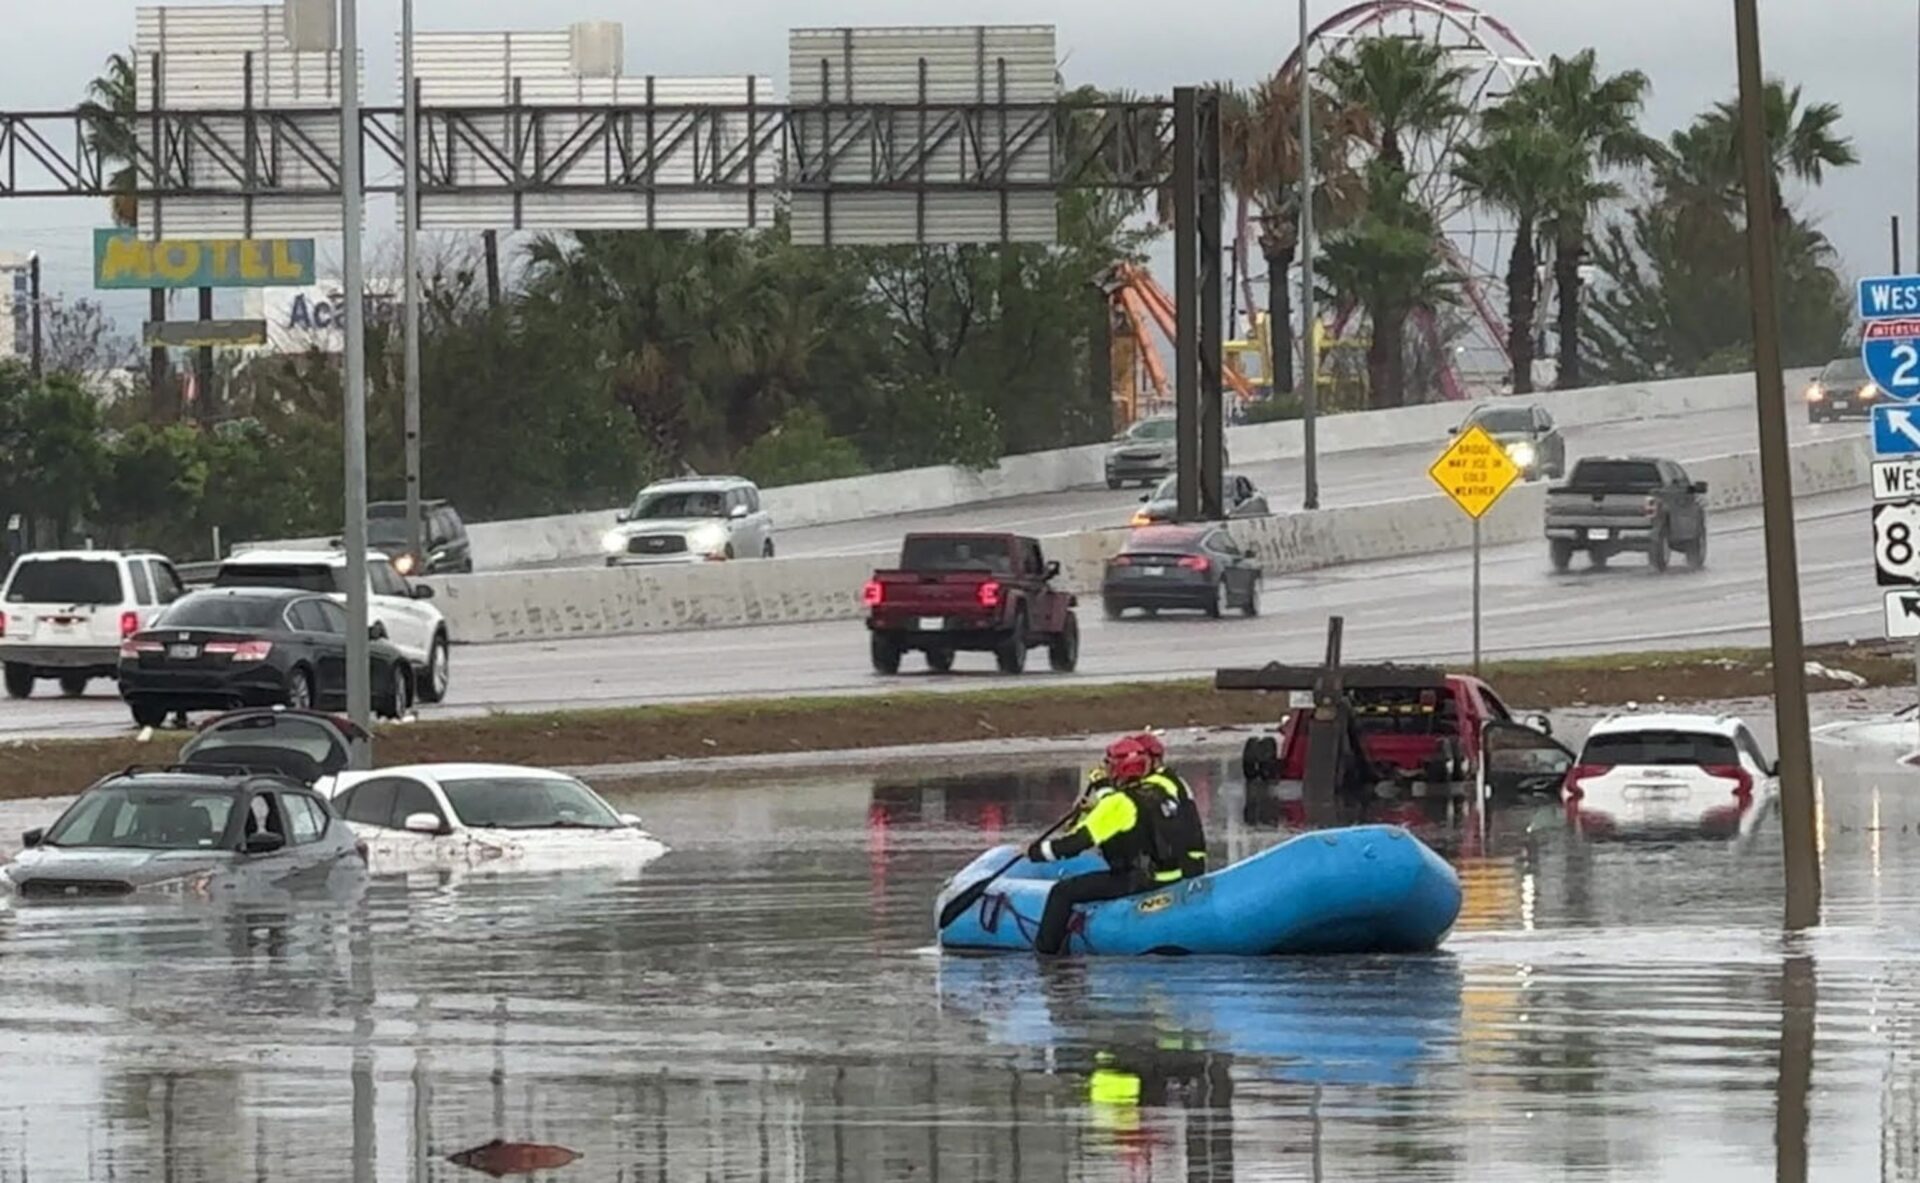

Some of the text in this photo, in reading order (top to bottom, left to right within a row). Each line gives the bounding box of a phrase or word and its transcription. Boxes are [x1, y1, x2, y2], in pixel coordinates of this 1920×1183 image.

[101, 235, 304, 281] MOTEL
[1871, 284, 1920, 312] WES
[1890, 345, 1920, 386] 2
[1886, 521, 1920, 566] 8
